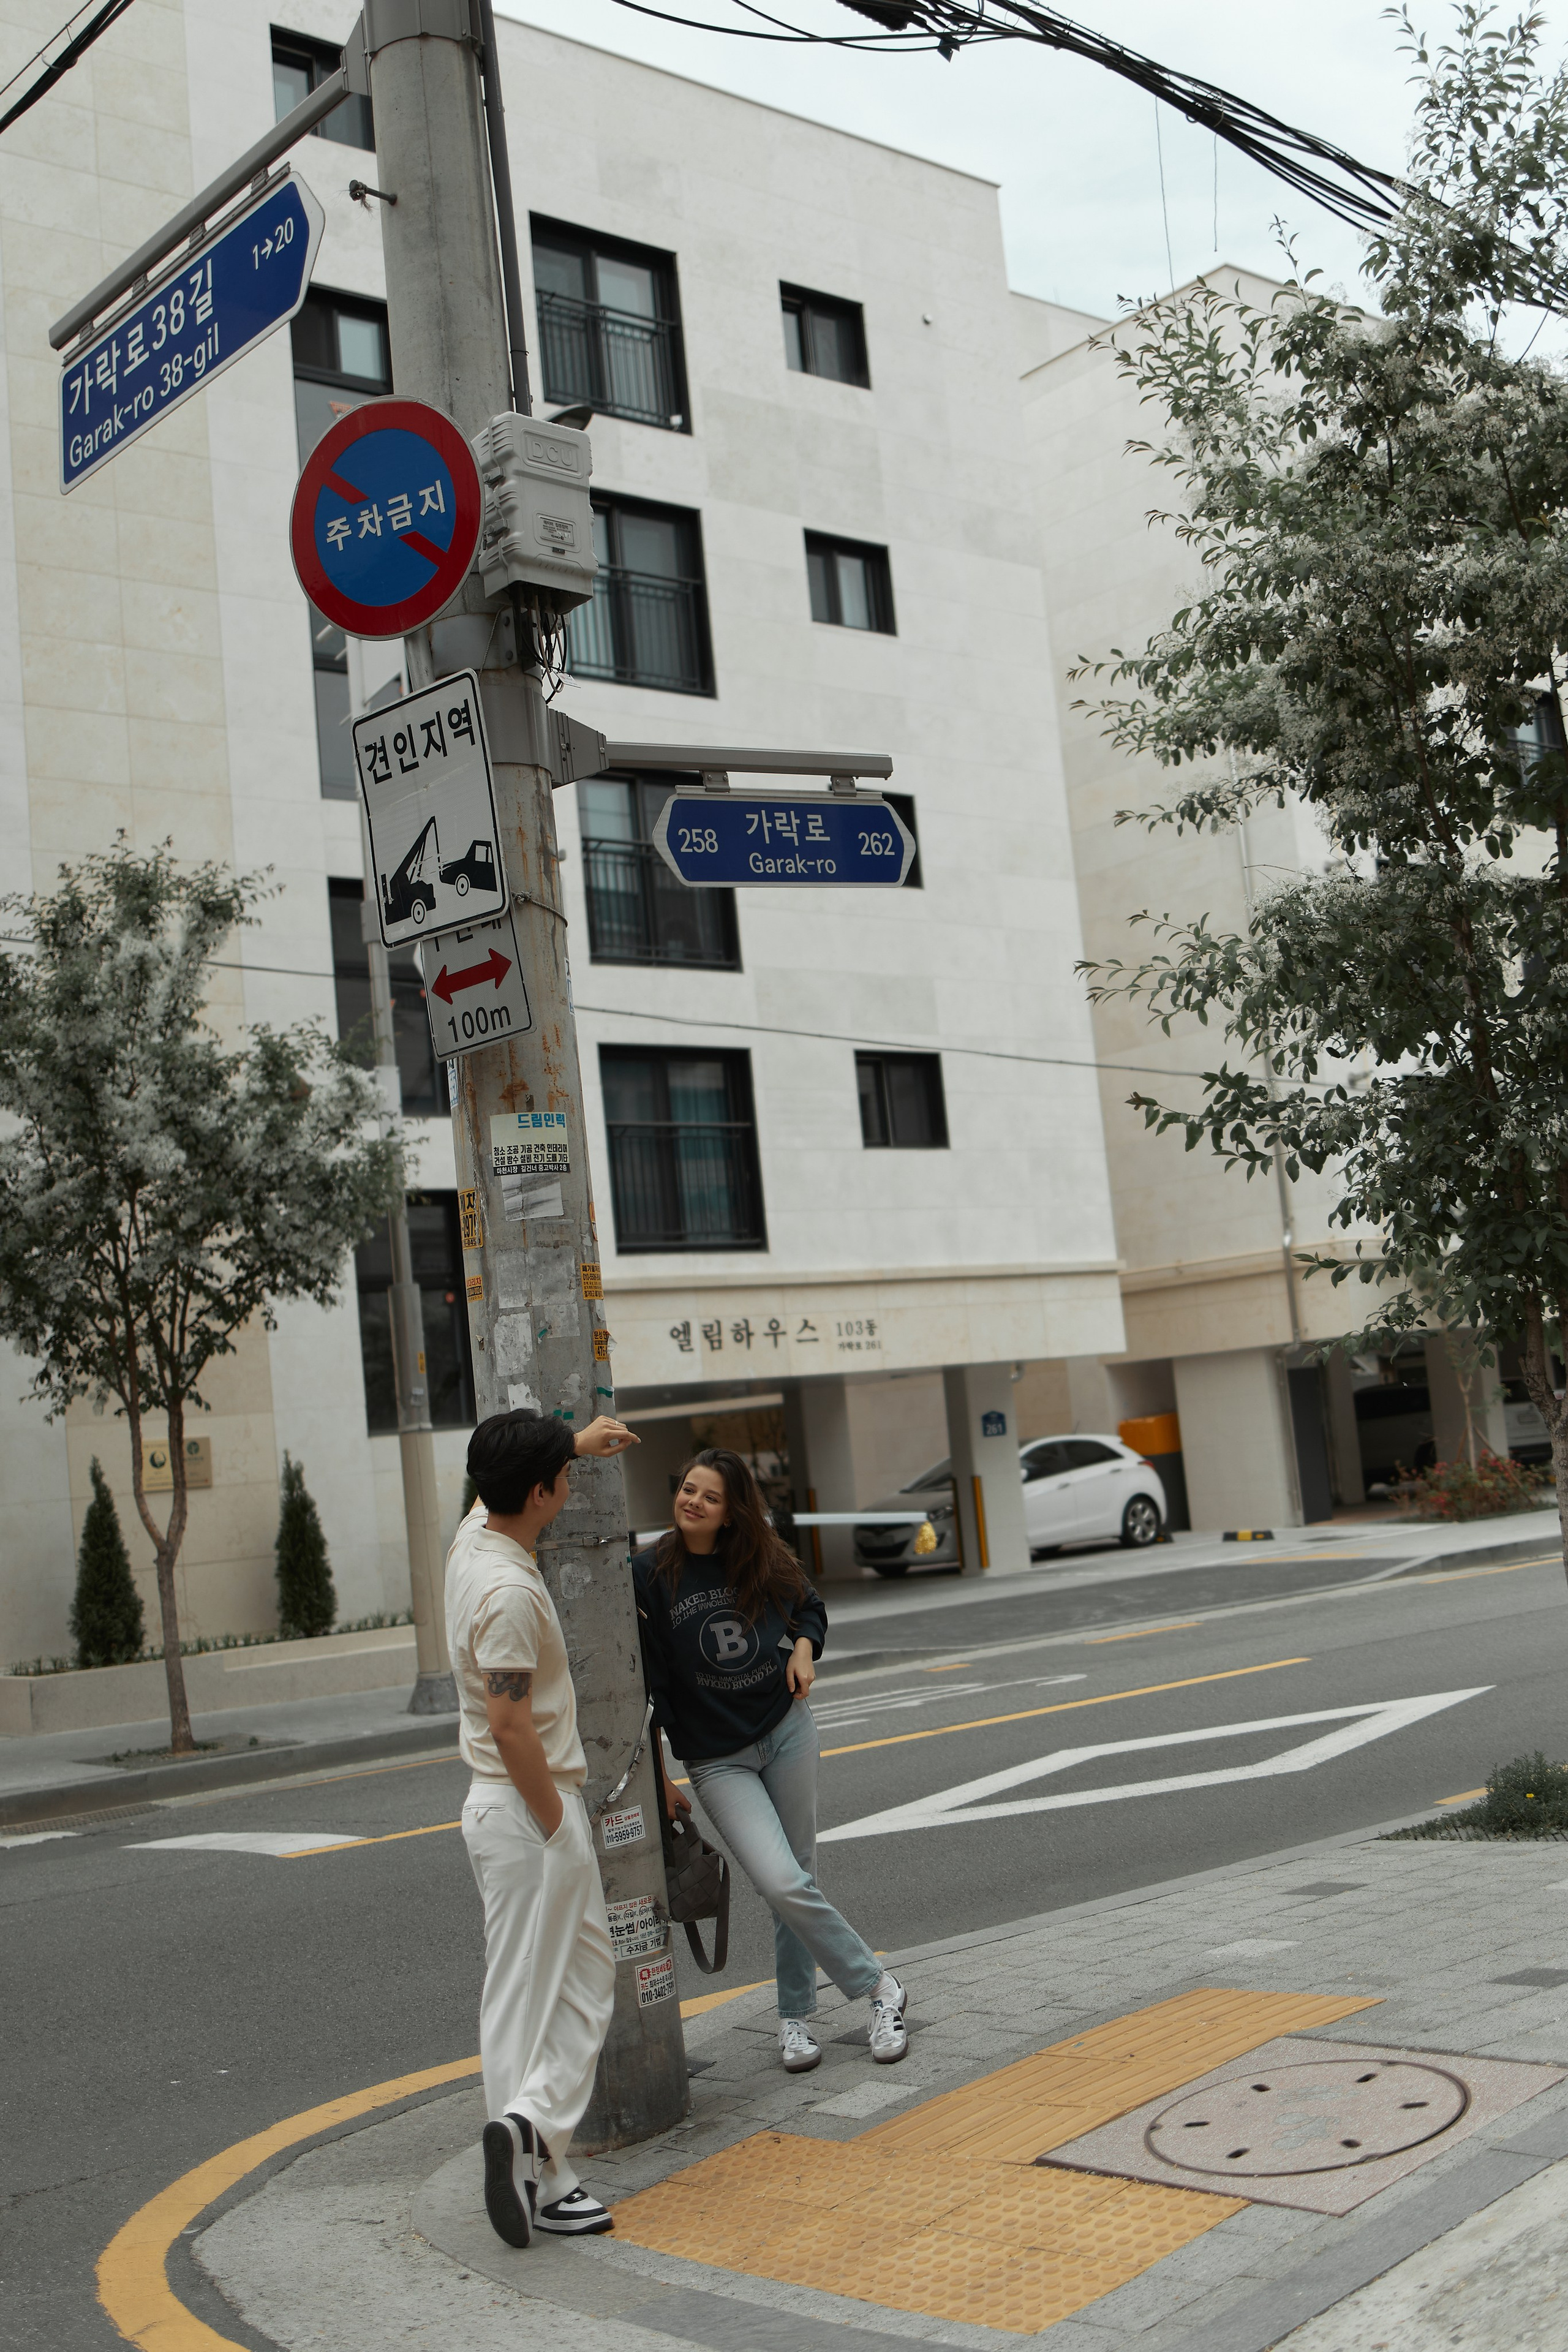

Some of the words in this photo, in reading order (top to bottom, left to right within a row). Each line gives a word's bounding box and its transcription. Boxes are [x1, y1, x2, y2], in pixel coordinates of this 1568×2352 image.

[69, 258, 213, 415] 가락로38길
[69, 385, 154, 468] Garak-ro
[160, 322, 219, 398] 38-gil
[532, 441, 573, 467] DCU
[326, 480, 446, 551] 주차금지
[364, 699, 476, 785] 견인지역
[745, 810, 831, 846] 가락로
[678, 828, 718, 853] 258
[858, 832, 895, 856] 262
[749, 852, 836, 873] Garak-ro
[448, 1006, 511, 1042] 100m
[518, 1113, 566, 1128] 드림인력
[494, 1147, 505, 1156] 청소
[507, 1145, 519, 1155] 조공
[521, 1144, 532, 1153] 기공
[534, 1144, 545, 1153] 건축
[547, 1144, 567, 1153] 인테리어
[494, 1156, 505, 1166] 건설
[520, 1154, 532, 1163] 설비
[533, 1153, 545, 1163] 전기
[559, 1153, 568, 1163] 기타
[670, 1317, 820, 1352] 엘림하우스
[836, 1319, 878, 1336] 103동
[669, 1592, 707, 1621] NAKED
[709, 1620, 748, 1662] B
[718, 1673, 752, 1683] IMMORTAL
[752, 1659, 772, 1675] PURITY
[605, 1815, 624, 1826] 카드
[606, 1825, 642, 1843] 010-5959-9757
[638, 1896, 652, 1906] 새로운
[626, 1941, 648, 1954] 수지금
[650, 1936, 661, 1947] 기법
[641, 1982, 649, 1991] 카드
